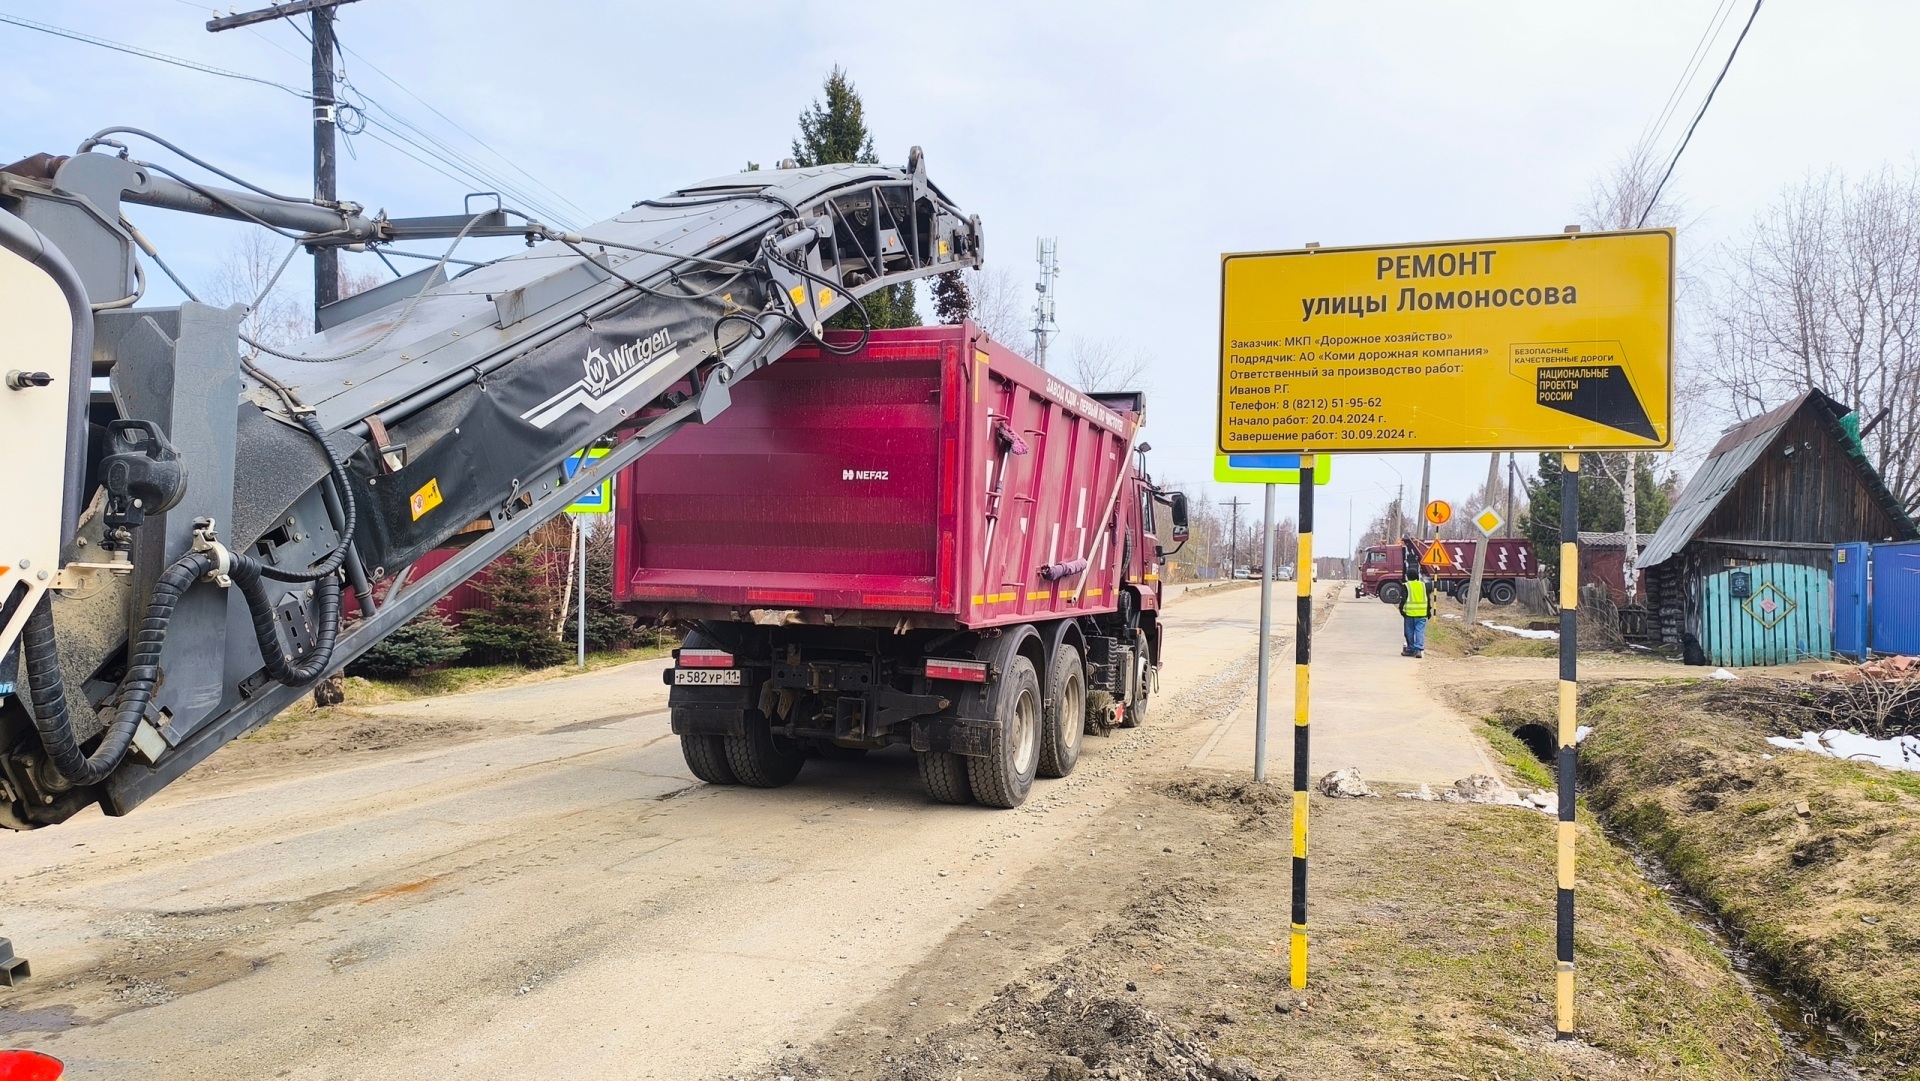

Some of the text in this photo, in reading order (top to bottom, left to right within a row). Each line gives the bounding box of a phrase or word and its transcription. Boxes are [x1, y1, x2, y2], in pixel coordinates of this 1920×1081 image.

[1376, 250, 1497, 280] РЕМОНТ
[1302, 285, 1577, 321] улицы Ломоносова
[1230, 331, 1453, 349] Заказчик: МКП «Дорожное хозяйство»
[608, 327, 672, 376] Wirtgen
[1230, 347, 1489, 365] Подрядчик: АО «Коми дорожная компания»
[1514, 347, 1569, 355] БЕЗОПАСНЫЕ
[1514, 355, 1614, 364] КАЧЕСТВЕННЫЕ ДОРОГИ
[1229, 363, 1464, 380] Ответственный за производство работ:
[1539, 368, 1609, 380] НАЦИОНАЛЬНЫЕ
[1046, 378, 1065, 403] ЗАВОД
[1229, 384, 1290, 395] Иванов Р.Г.
[1539, 380, 1579, 391] ПРОЕКТЫ
[1539, 391, 1573, 402] РОССИИ
[1229, 397, 1382, 412] Телефон: 8 (8212) 51-95-62
[1229, 413, 1387, 427] Начало работ: 20.04.2024 г.
[1229, 429, 1418, 443] Завершение работ: 30.09.2024 г.
[856, 471, 888, 480] NEFAZ
